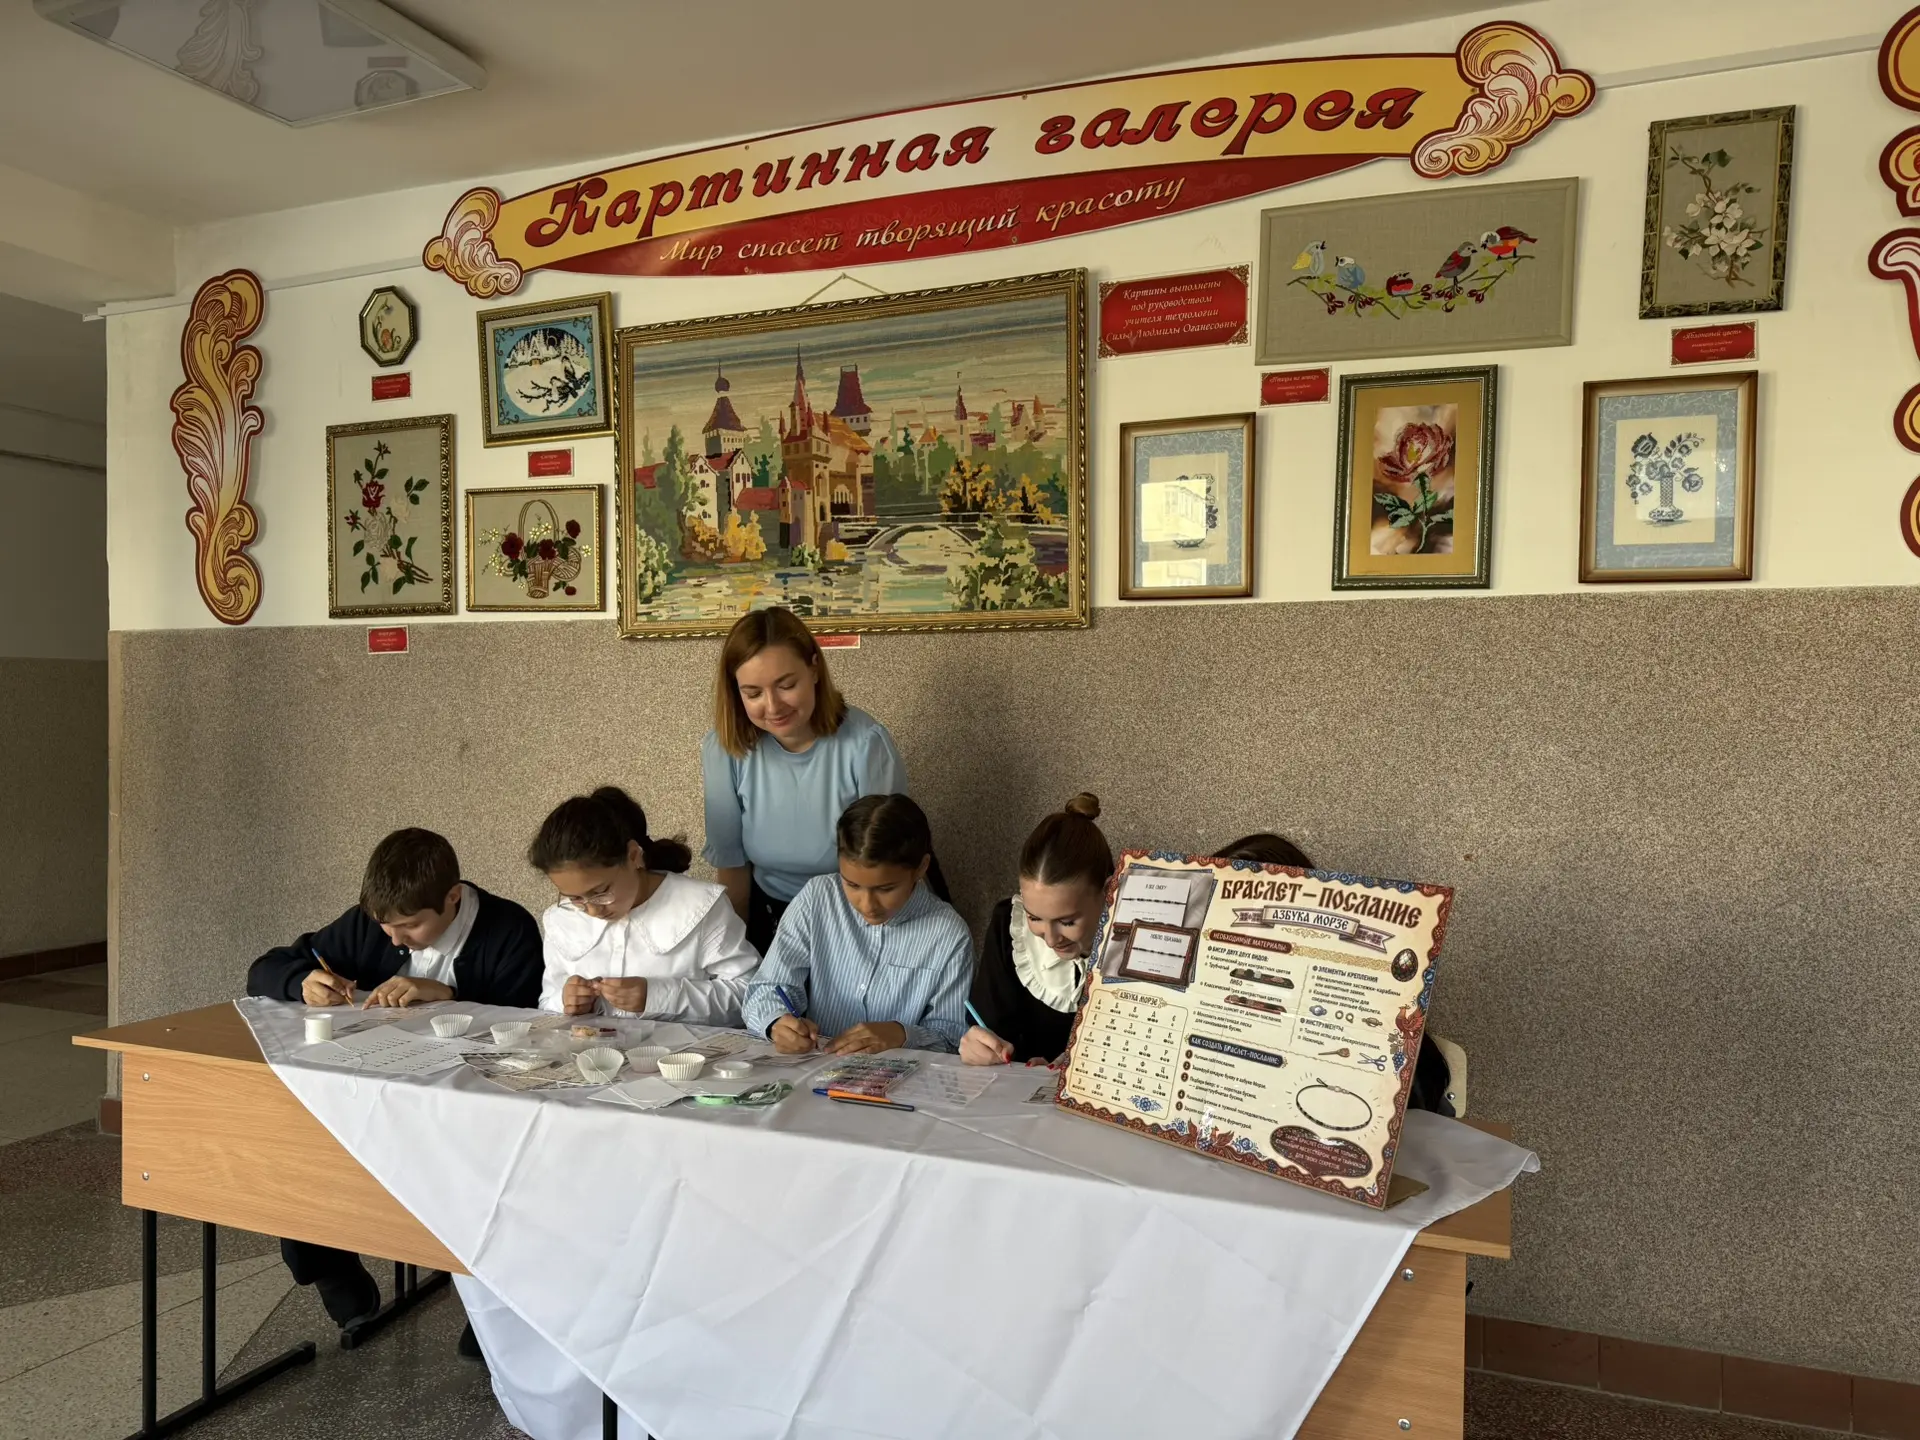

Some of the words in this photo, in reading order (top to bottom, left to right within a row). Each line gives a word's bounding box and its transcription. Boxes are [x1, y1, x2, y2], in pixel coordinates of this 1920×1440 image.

[524, 126, 997, 248] Картинная
[1034, 87, 1427, 156] галерея
[659, 239, 723, 268] Мир
[738, 232, 841, 257] спасет
[855, 207, 1018, 252] творящий
[1036, 174, 1187, 230] красоту
[1123, 287, 1167, 300] Картины
[1169, 280, 1221, 293] выполнены
[1130, 302, 1146, 312] под
[1148, 295, 1212, 312] руководством
[1123, 315, 1162, 328] учителя
[1165, 309, 1219, 321] технологии
[1135, 326, 1181, 339] Людмилы
[1183, 320, 1238, 333] Оганесовны
[1221, 880, 1303, 903] БРАСЛЕТ
[1318, 887, 1422, 928] ПОСЛАНИЕ
[1272, 909, 1310, 923] АЗБУКА
[1313, 914, 1349, 931] МОРЗЕ
[1213, 933, 1250, 944] НЕОБХОДИМЫЕ
[1318, 966, 1346, 976] ЭЛЕМЕНТЫ
[1119, 991, 1138, 1001] АЗБУКА
[1139, 995, 1158, 1005] МОРЗЕ
